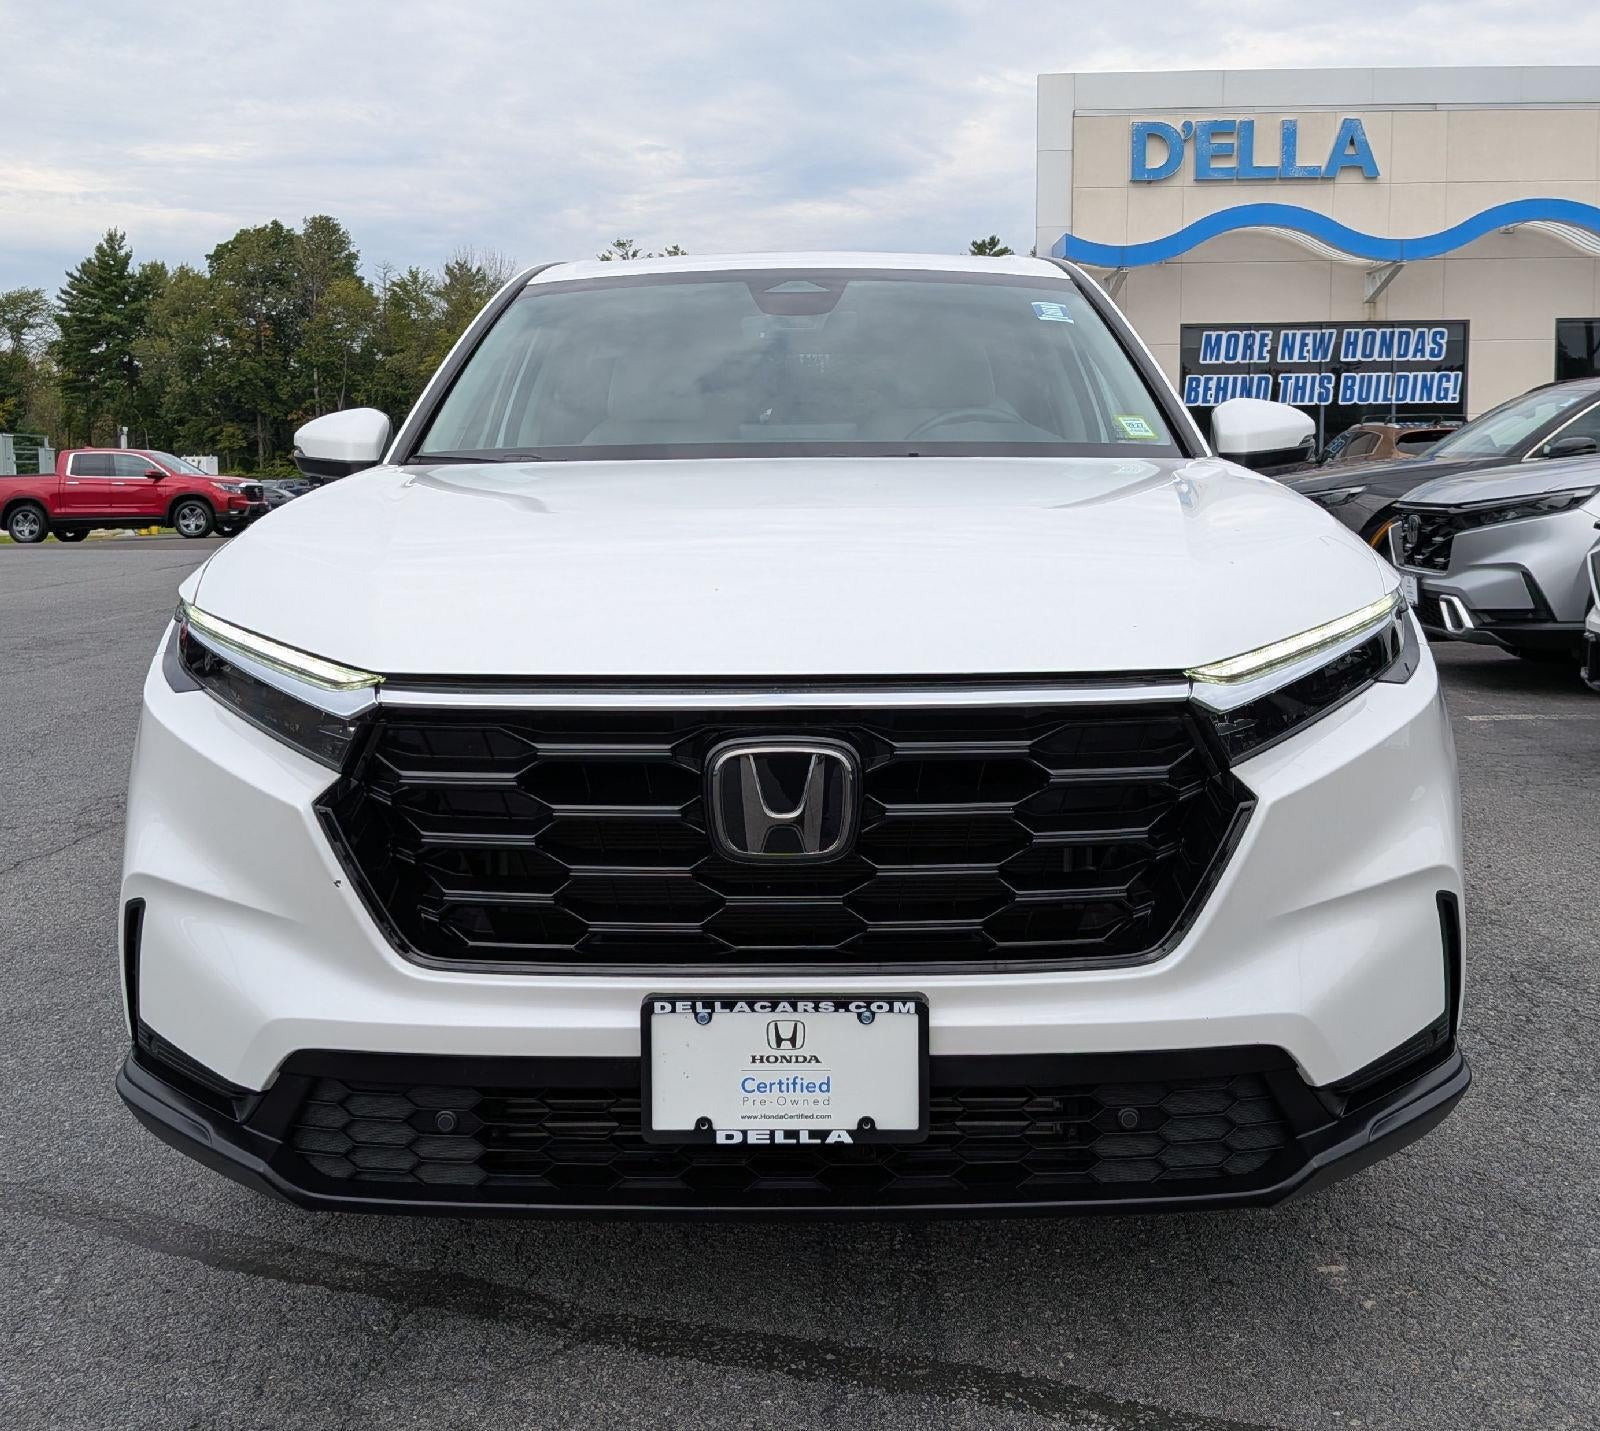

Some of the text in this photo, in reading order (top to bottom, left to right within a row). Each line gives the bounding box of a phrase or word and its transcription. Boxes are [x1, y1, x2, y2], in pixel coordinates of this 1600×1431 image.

[1130, 117, 1381, 183] D'ELLA
[1200, 328, 1448, 364] MORE NEW HONDAS
[1184, 372, 1462, 406] BEHIND THIS BUILDING!
[653, 1001, 917, 1014] DELLACARS.COM
[750, 1054, 823, 1064] HONDA
[740, 1075, 832, 1094] Certified
[742, 1096, 831, 1107] Pre-Owned
[740, 1112, 832, 1121] www.HondaCertified.com
[715, 1129, 854, 1145] DELLA
